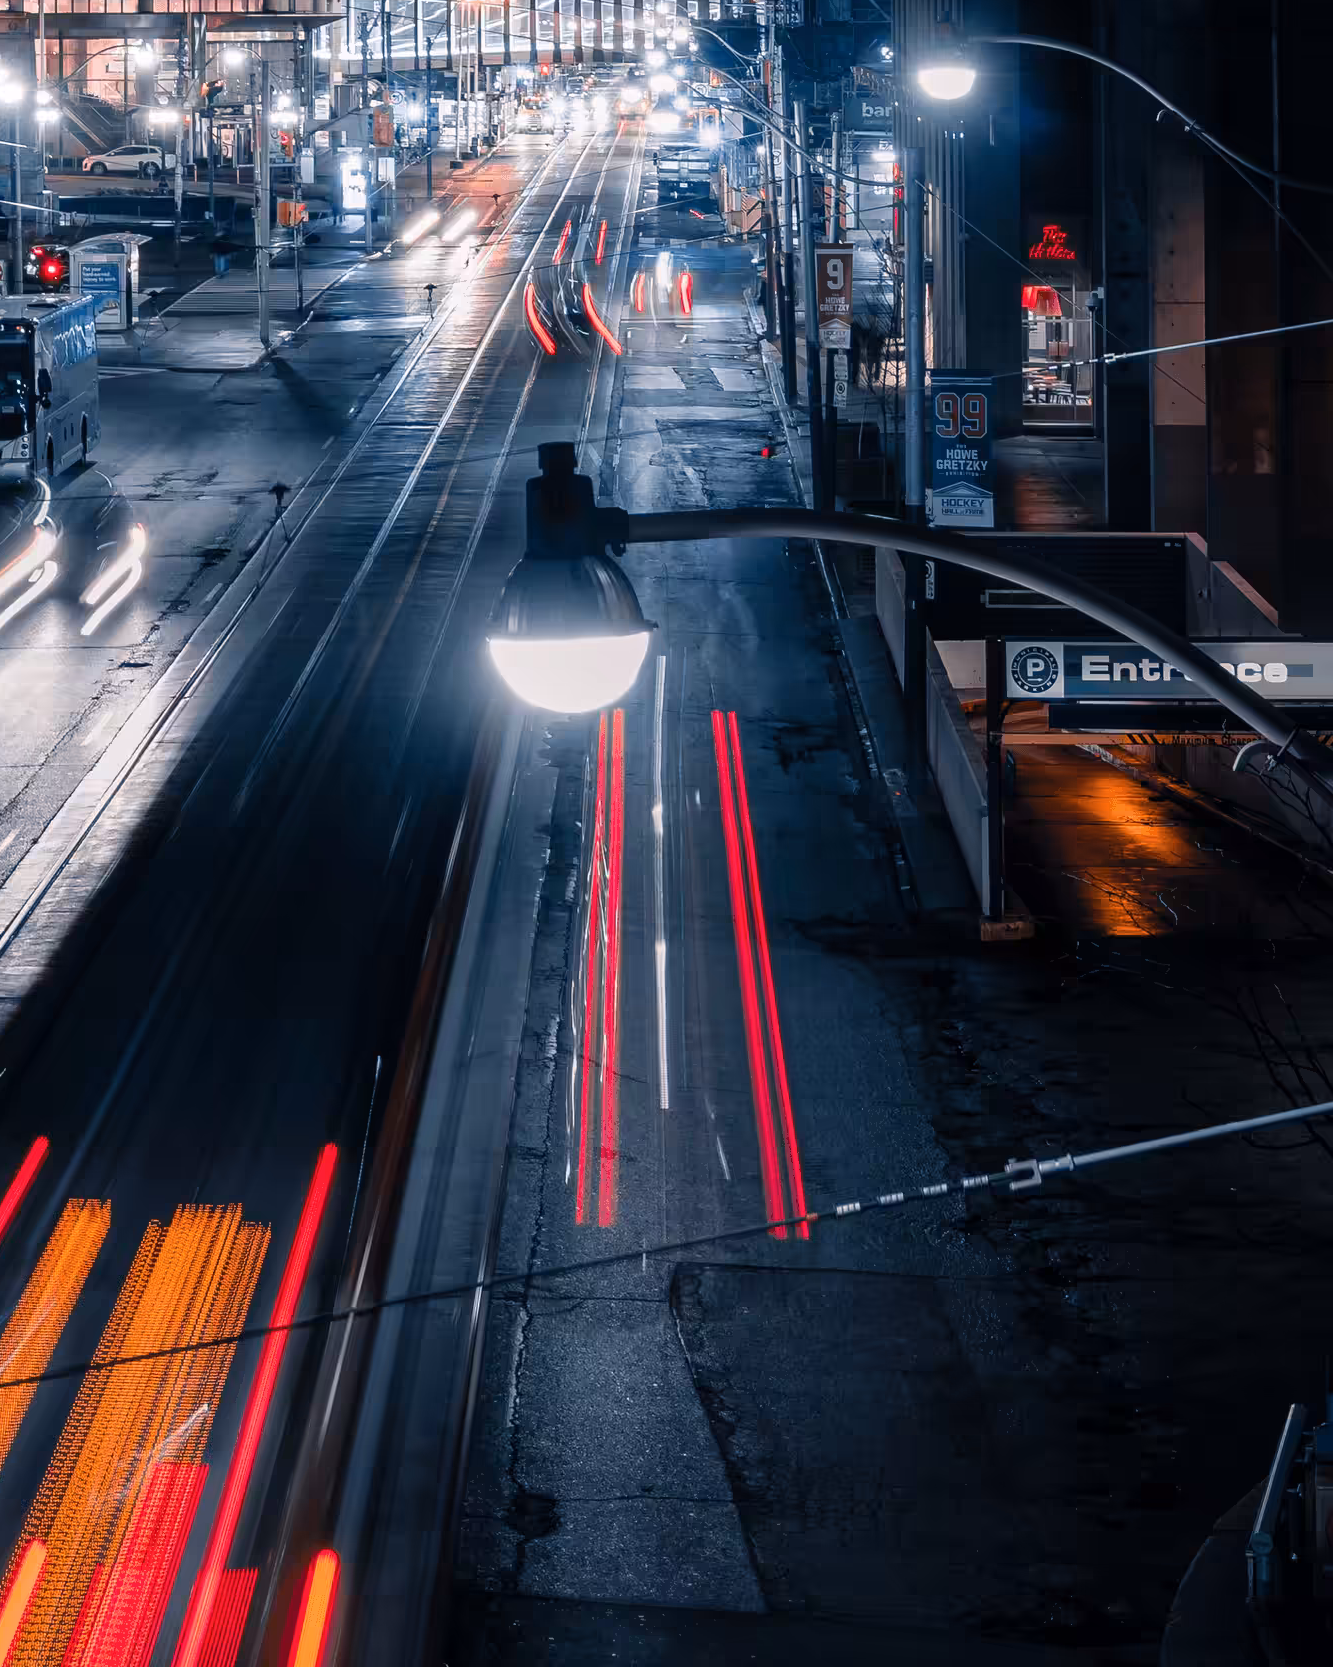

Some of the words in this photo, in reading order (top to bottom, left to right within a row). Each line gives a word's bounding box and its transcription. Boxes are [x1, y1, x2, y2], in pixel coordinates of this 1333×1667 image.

[826, 258, 844, 290] 9
[820, 304, 850, 312] GRETZKY
[935, 392, 987, 438] 99
[946, 449, 978, 459] HOWE
[936, 459, 988, 470] GRETZKY
[941, 498, 984, 507] HOCKEY
[1027, 658, 1045, 677] P
[1081, 655, 1289, 682] Entrce
